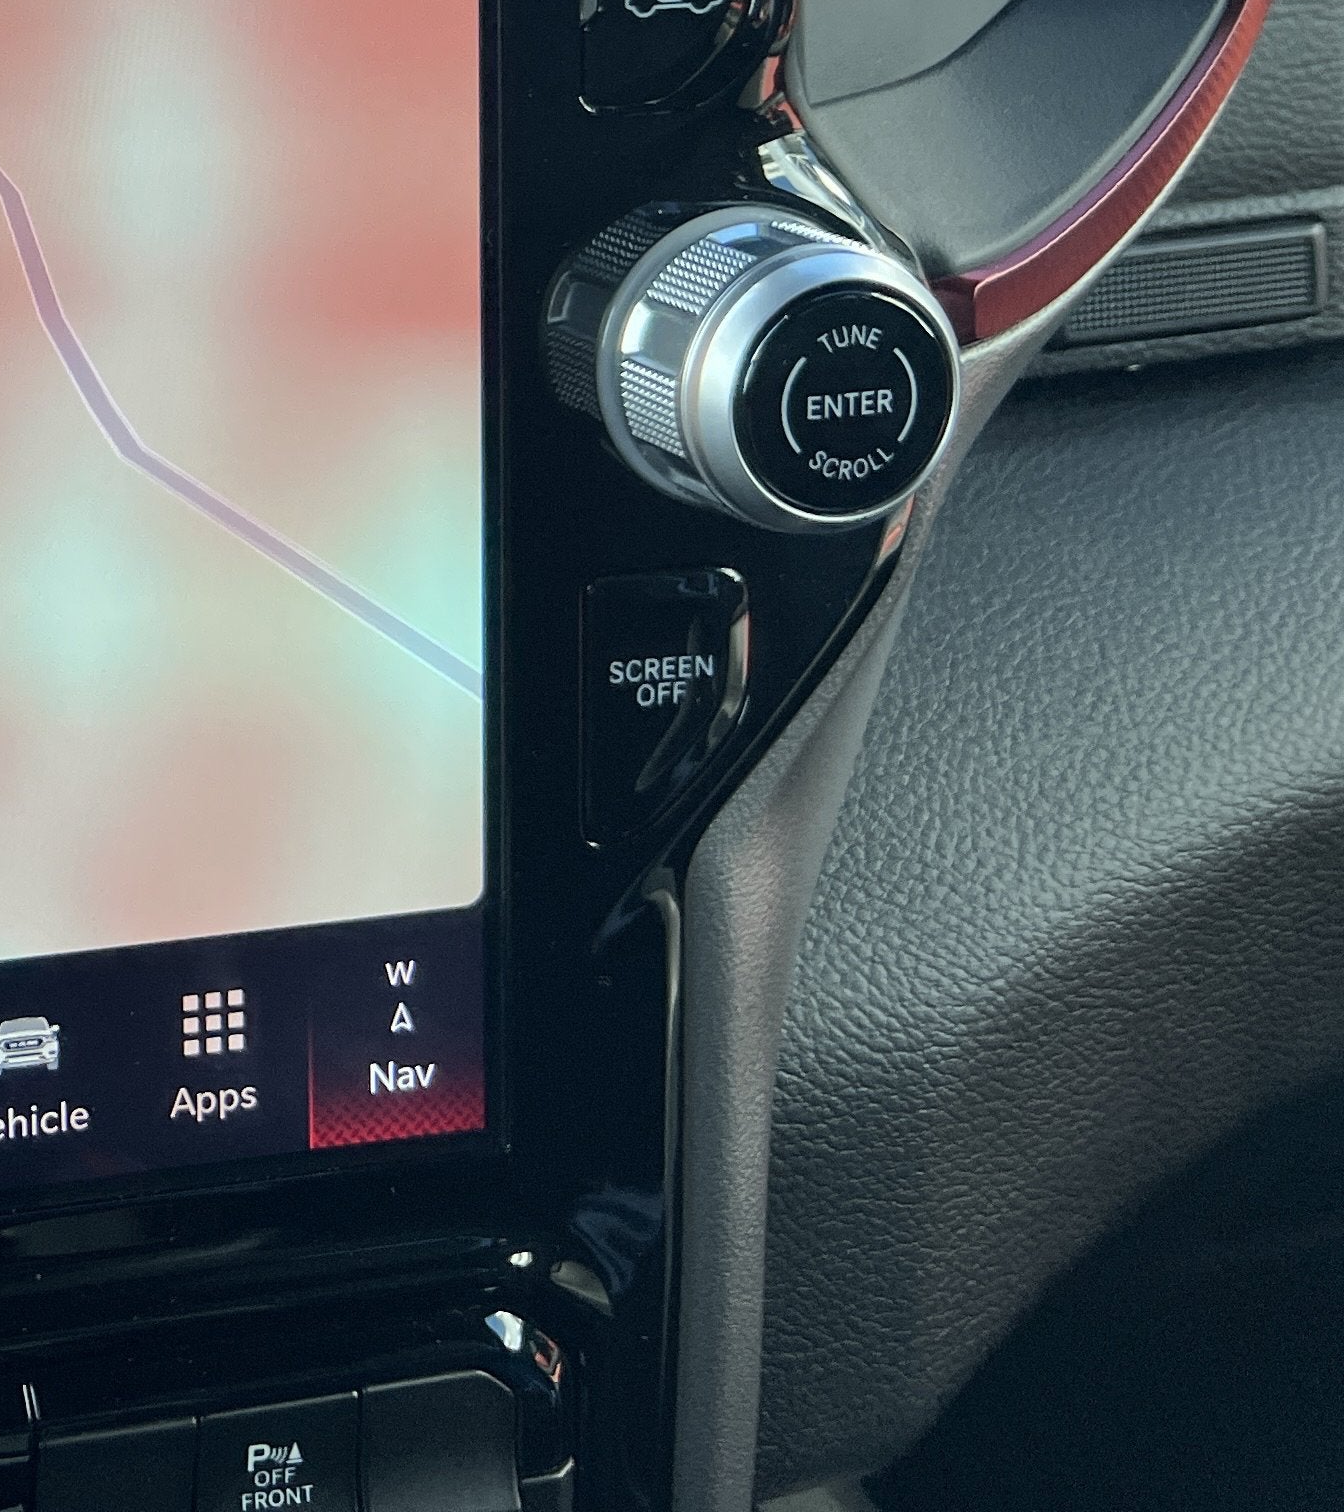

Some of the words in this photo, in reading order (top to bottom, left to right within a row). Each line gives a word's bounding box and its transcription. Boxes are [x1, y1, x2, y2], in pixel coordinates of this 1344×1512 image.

[817, 324, 883, 355] TUNE
[806, 389, 893, 420] ENTER
[809, 448, 895, 481] SCROLL
[609, 655, 713, 685] SCREEN
[636, 681, 687, 708] OFF
[385, 959, 416, 987] W
[369, 1060, 436, 1095] Nav
[170, 1082, 258, 1122] Apps
[254, 1467, 297, 1487] OFF
[241, 1484, 314, 1512] FRONT
